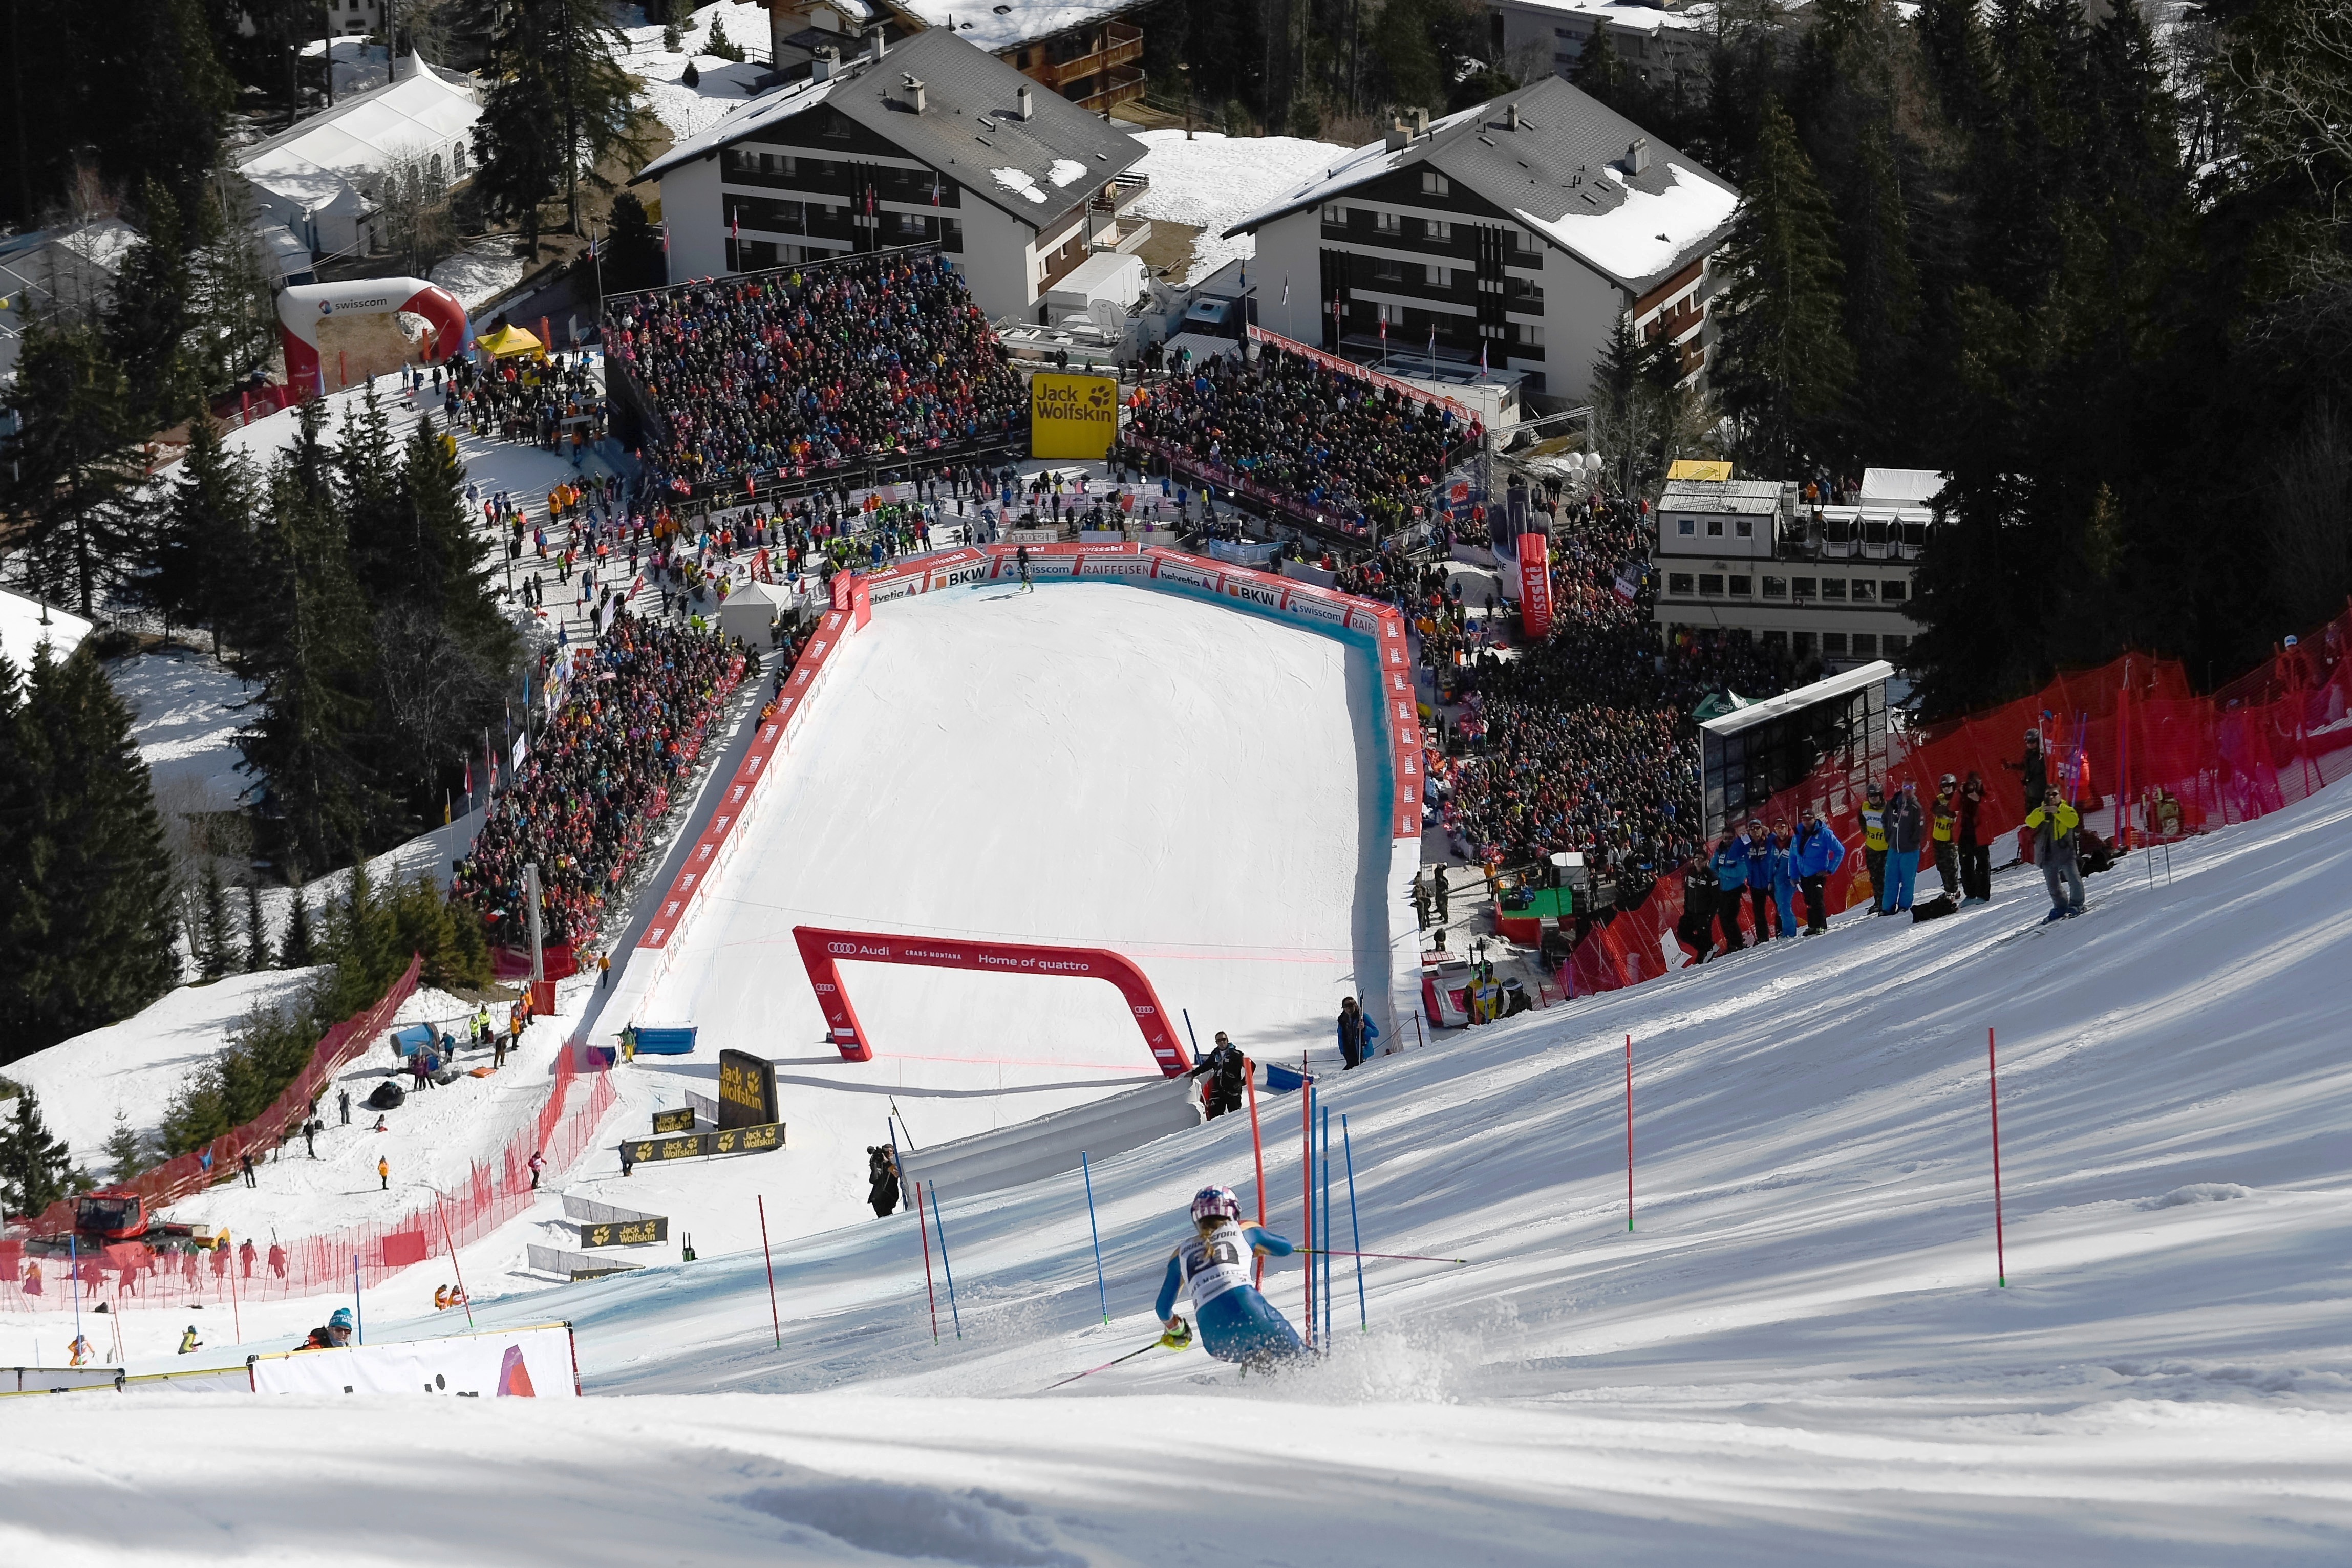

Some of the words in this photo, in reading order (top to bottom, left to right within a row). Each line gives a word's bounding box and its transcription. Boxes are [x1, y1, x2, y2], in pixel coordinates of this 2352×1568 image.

[335, 298, 387, 310] swisscom
[1036, 383, 1079, 402] Jack
[1036, 402, 1111, 422] Wolfskin
[1451, 494, 1467, 503] Valais
[927, 552, 968, 567] swissski
[1156, 549, 1196, 563] swissski
[1017, 564, 1070, 574] sisscom
[1084, 565, 1149, 575] RAIFFEISEN
[950, 566, 986, 586] BKW
[1161, 570, 1200, 587] helvetia
[869, 589, 904, 604] elvetia
[1241, 587, 1274, 606] BKW
[1525, 566, 1548, 632] swissski
[1299, 605, 1341, 622] swisscom
[860, 946, 890, 956] Audi
[905, 949, 927, 957] CRANS
[930, 952, 961, 960] MONTANA
[978, 954, 1017, 966] Home
[1021, 958, 1035, 967] of
[1039, 961, 1089, 971] quattro
[720, 1063, 743, 1087] Jack
[720, 1081, 762, 1110] Wolfskin
[657, 1114, 677, 1125] Jack
[657, 1120, 693, 1133] Wolfskin
[743, 1130, 762, 1140] Jack
[662, 1140, 682, 1150] Jack
[743, 1137, 776, 1149] Wolfskin
[662, 1148, 698, 1159] Wolfskin
[619, 1225, 639, 1235] Jack
[619, 1232, 655, 1243] Wolfskin
